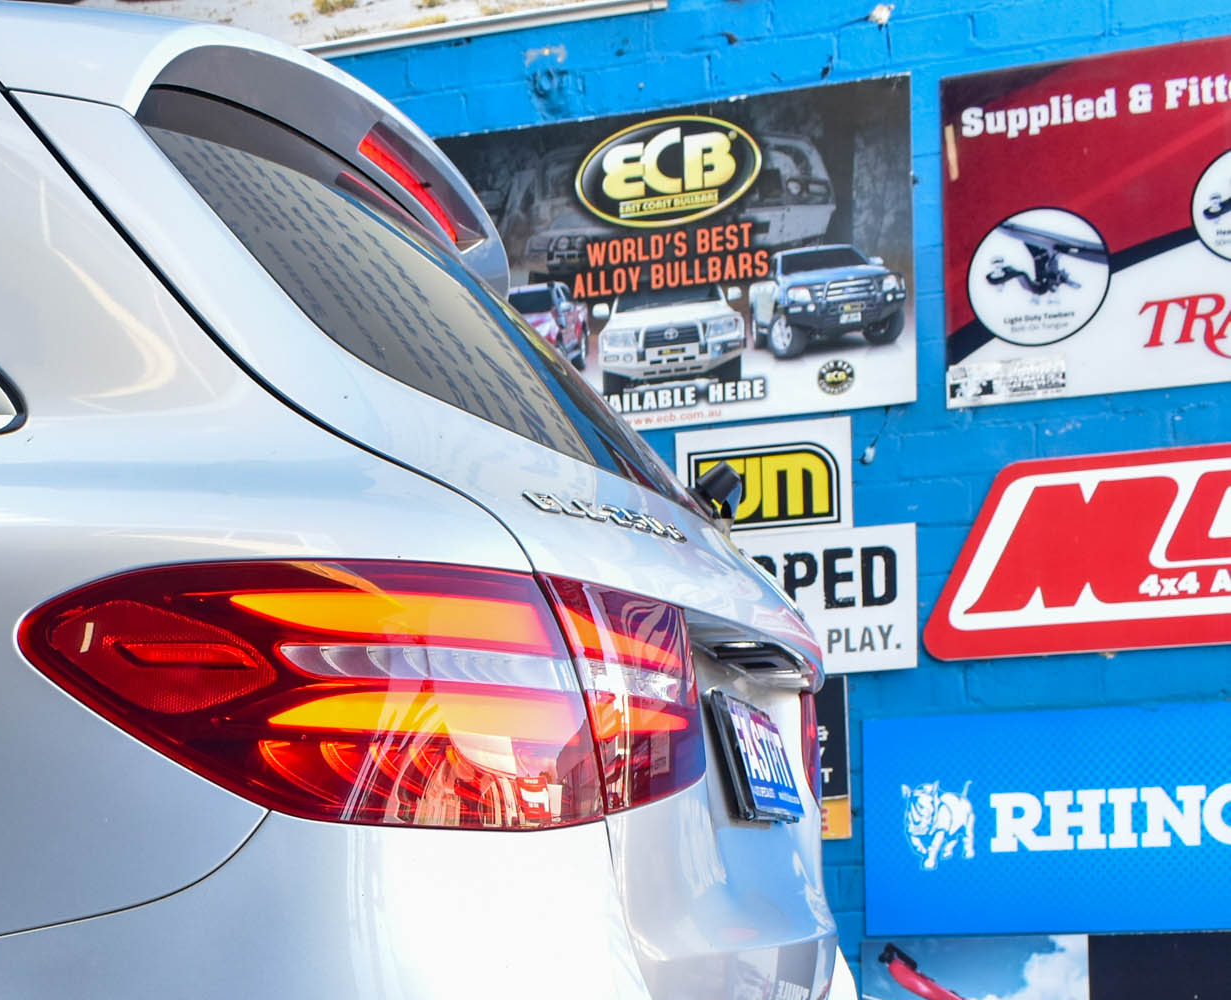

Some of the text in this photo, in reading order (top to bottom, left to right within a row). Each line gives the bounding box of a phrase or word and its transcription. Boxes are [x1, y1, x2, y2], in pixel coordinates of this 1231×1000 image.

[961, 73, 1231, 139] Supplied & Fitt
[602, 127, 736, 200] ECB
[587, 222, 753, 268] WORLD'S BEST
[573, 250, 769, 299] ALLOY BULLBARS
[708, 378, 765, 404] HERE
[1138, 570, 1201, 597] 4x4
[827, 624, 903, 654] PLAY.
